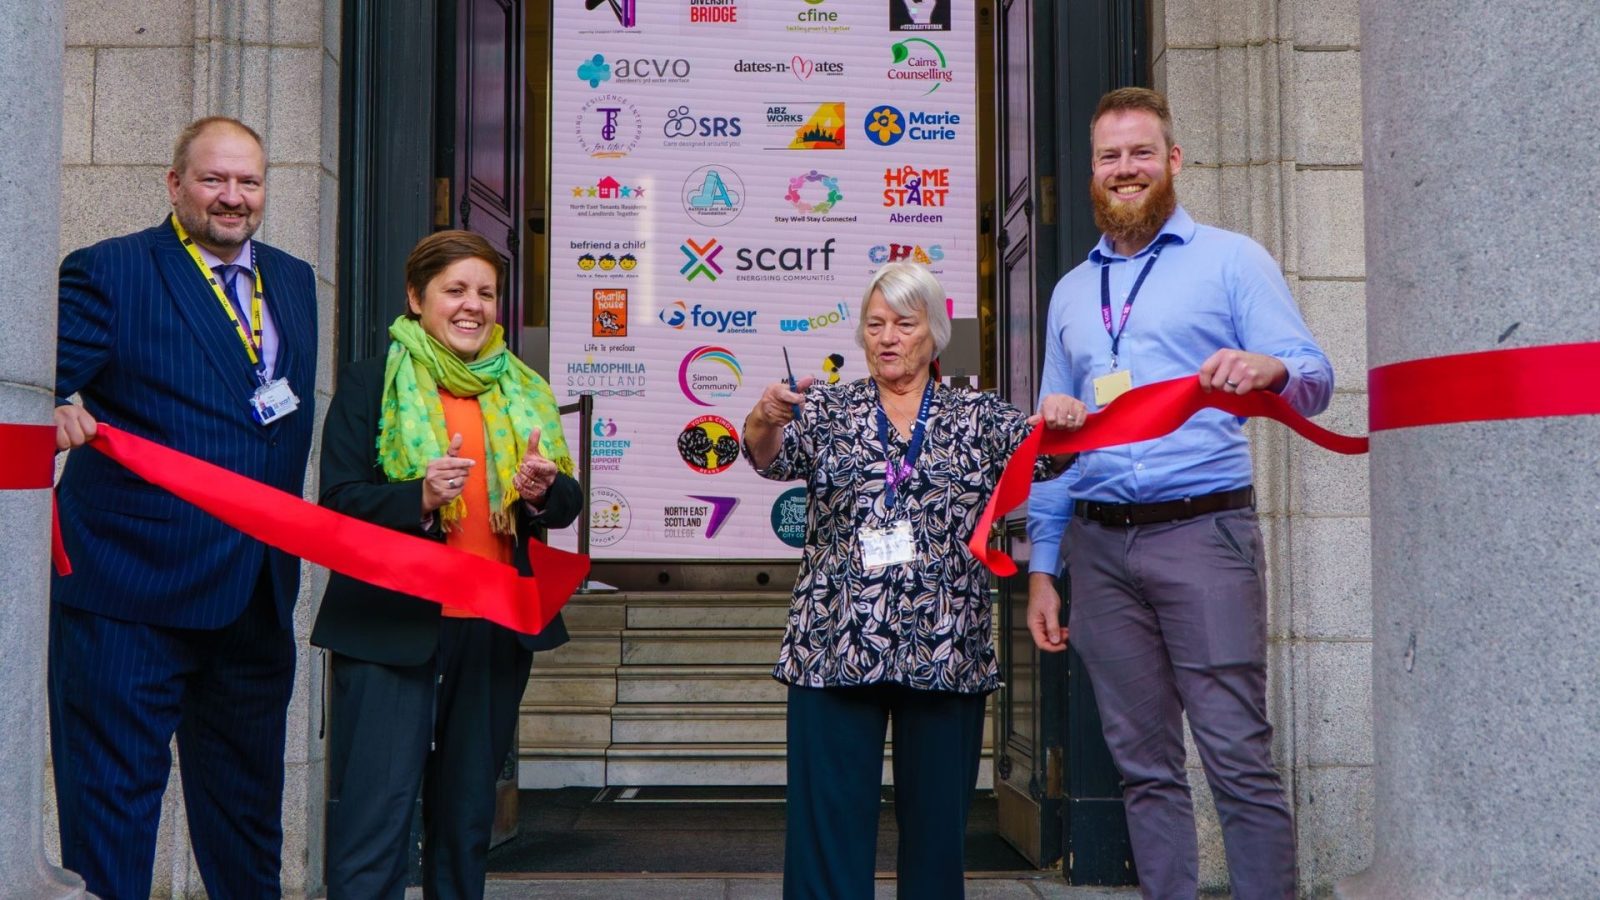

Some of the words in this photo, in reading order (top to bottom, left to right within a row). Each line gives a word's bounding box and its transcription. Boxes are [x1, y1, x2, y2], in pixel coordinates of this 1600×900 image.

[690, 6, 737, 22] BRIDGE
[797, 8, 838, 22] cfine
[907, 57, 937, 67] Cairns
[614, 58, 691, 78] acvo
[887, 68, 953, 82] Counselling
[909, 111, 960, 124] Marie
[699, 117, 742, 137] SRS
[909, 127, 956, 140] Curie
[884, 165, 949, 187] HOME
[883, 188, 949, 207] START
[889, 213, 943, 223] Aberdeen
[570, 240, 612, 249] befriend
[622, 240, 646, 249] child
[735, 238, 836, 271] scarf
[868, 243, 945, 264] CHAS
[595, 291, 626, 301] Charlie
[599, 301, 625, 309] house
[691, 304, 757, 333] foyer
[609, 344, 635, 353] precious
[567, 363, 646, 374] HAEMOPHILIA
[567, 376, 646, 386] SCOTLAND
[692, 373, 718, 381] Simon
[692, 382, 738, 391] Community
[592, 440, 631, 448] ERDEEN
[664, 506, 688, 516] NORTH
[689, 506, 708, 516] EAST
[664, 517, 702, 527] SCOTLAND
[664, 528, 695, 538] COLLEGE
[777, 524, 805, 533] ABERD
